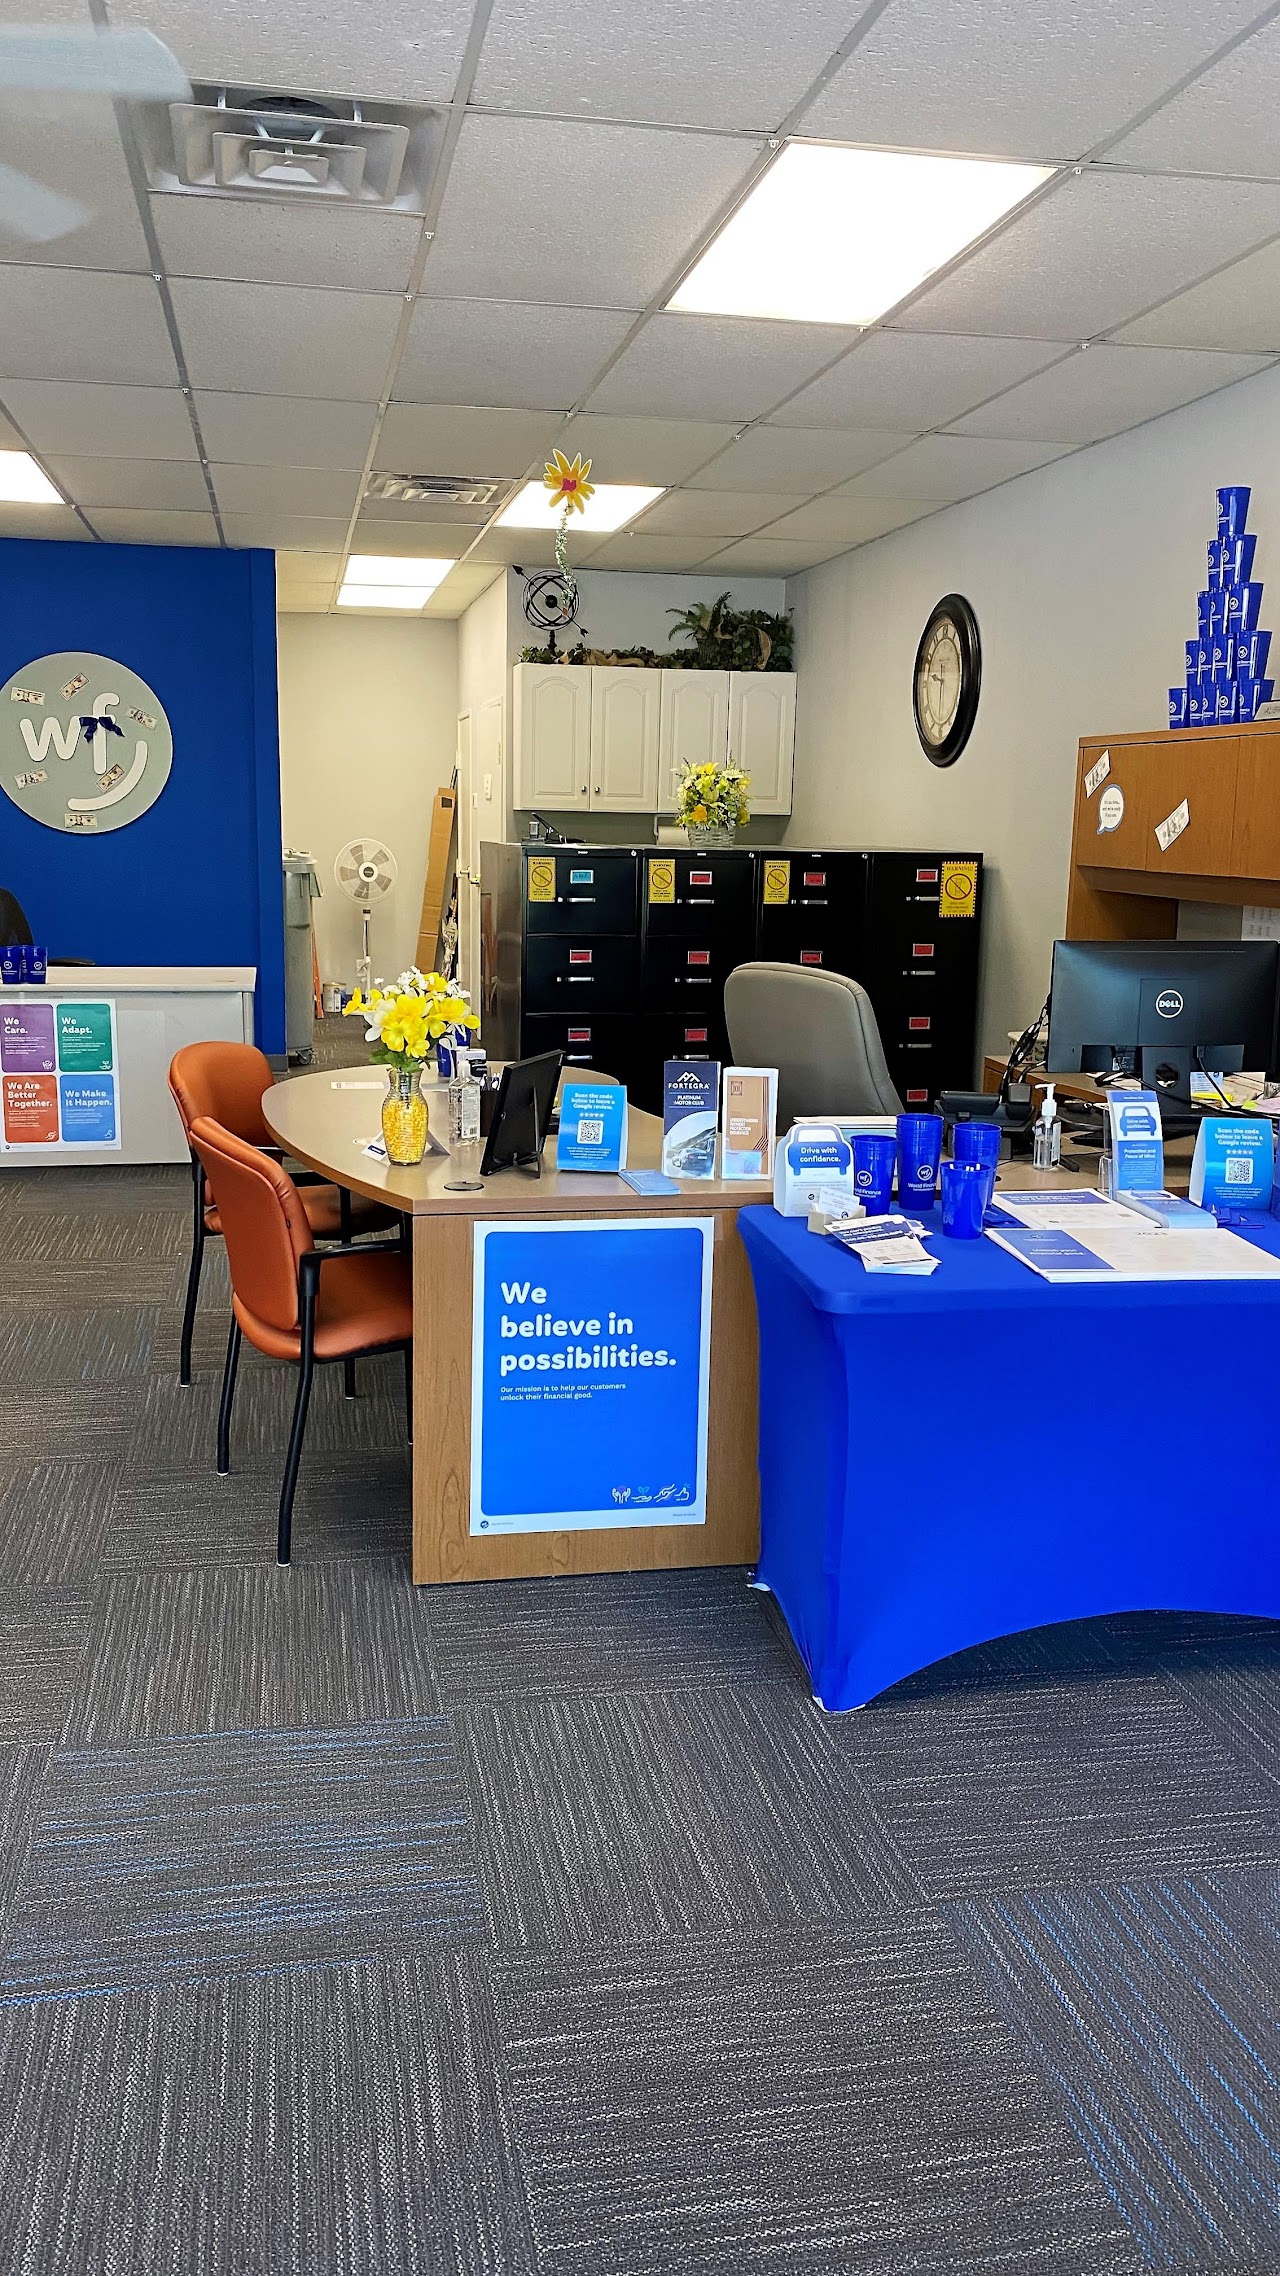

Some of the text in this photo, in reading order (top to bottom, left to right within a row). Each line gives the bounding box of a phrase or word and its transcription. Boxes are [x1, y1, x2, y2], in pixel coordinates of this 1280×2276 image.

[1159, 1000, 1180, 1008] DELL
[4, 1017, 19, 1025] We
[62, 1017, 76, 1025] We
[4, 1026, 28, 1034] Care.
[62, 1025, 93, 1035] Adapt.
[7, 1082, 23, 1090] We
[7, 1091, 37, 1099] Better
[65, 1089, 107, 1098] We Make
[8, 1099, 53, 1109] Together.
[66, 1098, 113, 1108] It Happen.
[501, 1281, 547, 1304] We
[500, 1311, 633, 1338] believe in
[500, 1343, 677, 1377] possibilities.
[560, 1384, 575, 1392] help
[500, 1393, 524, 1401] unlock
[574, 1392, 593, 1400] good.
